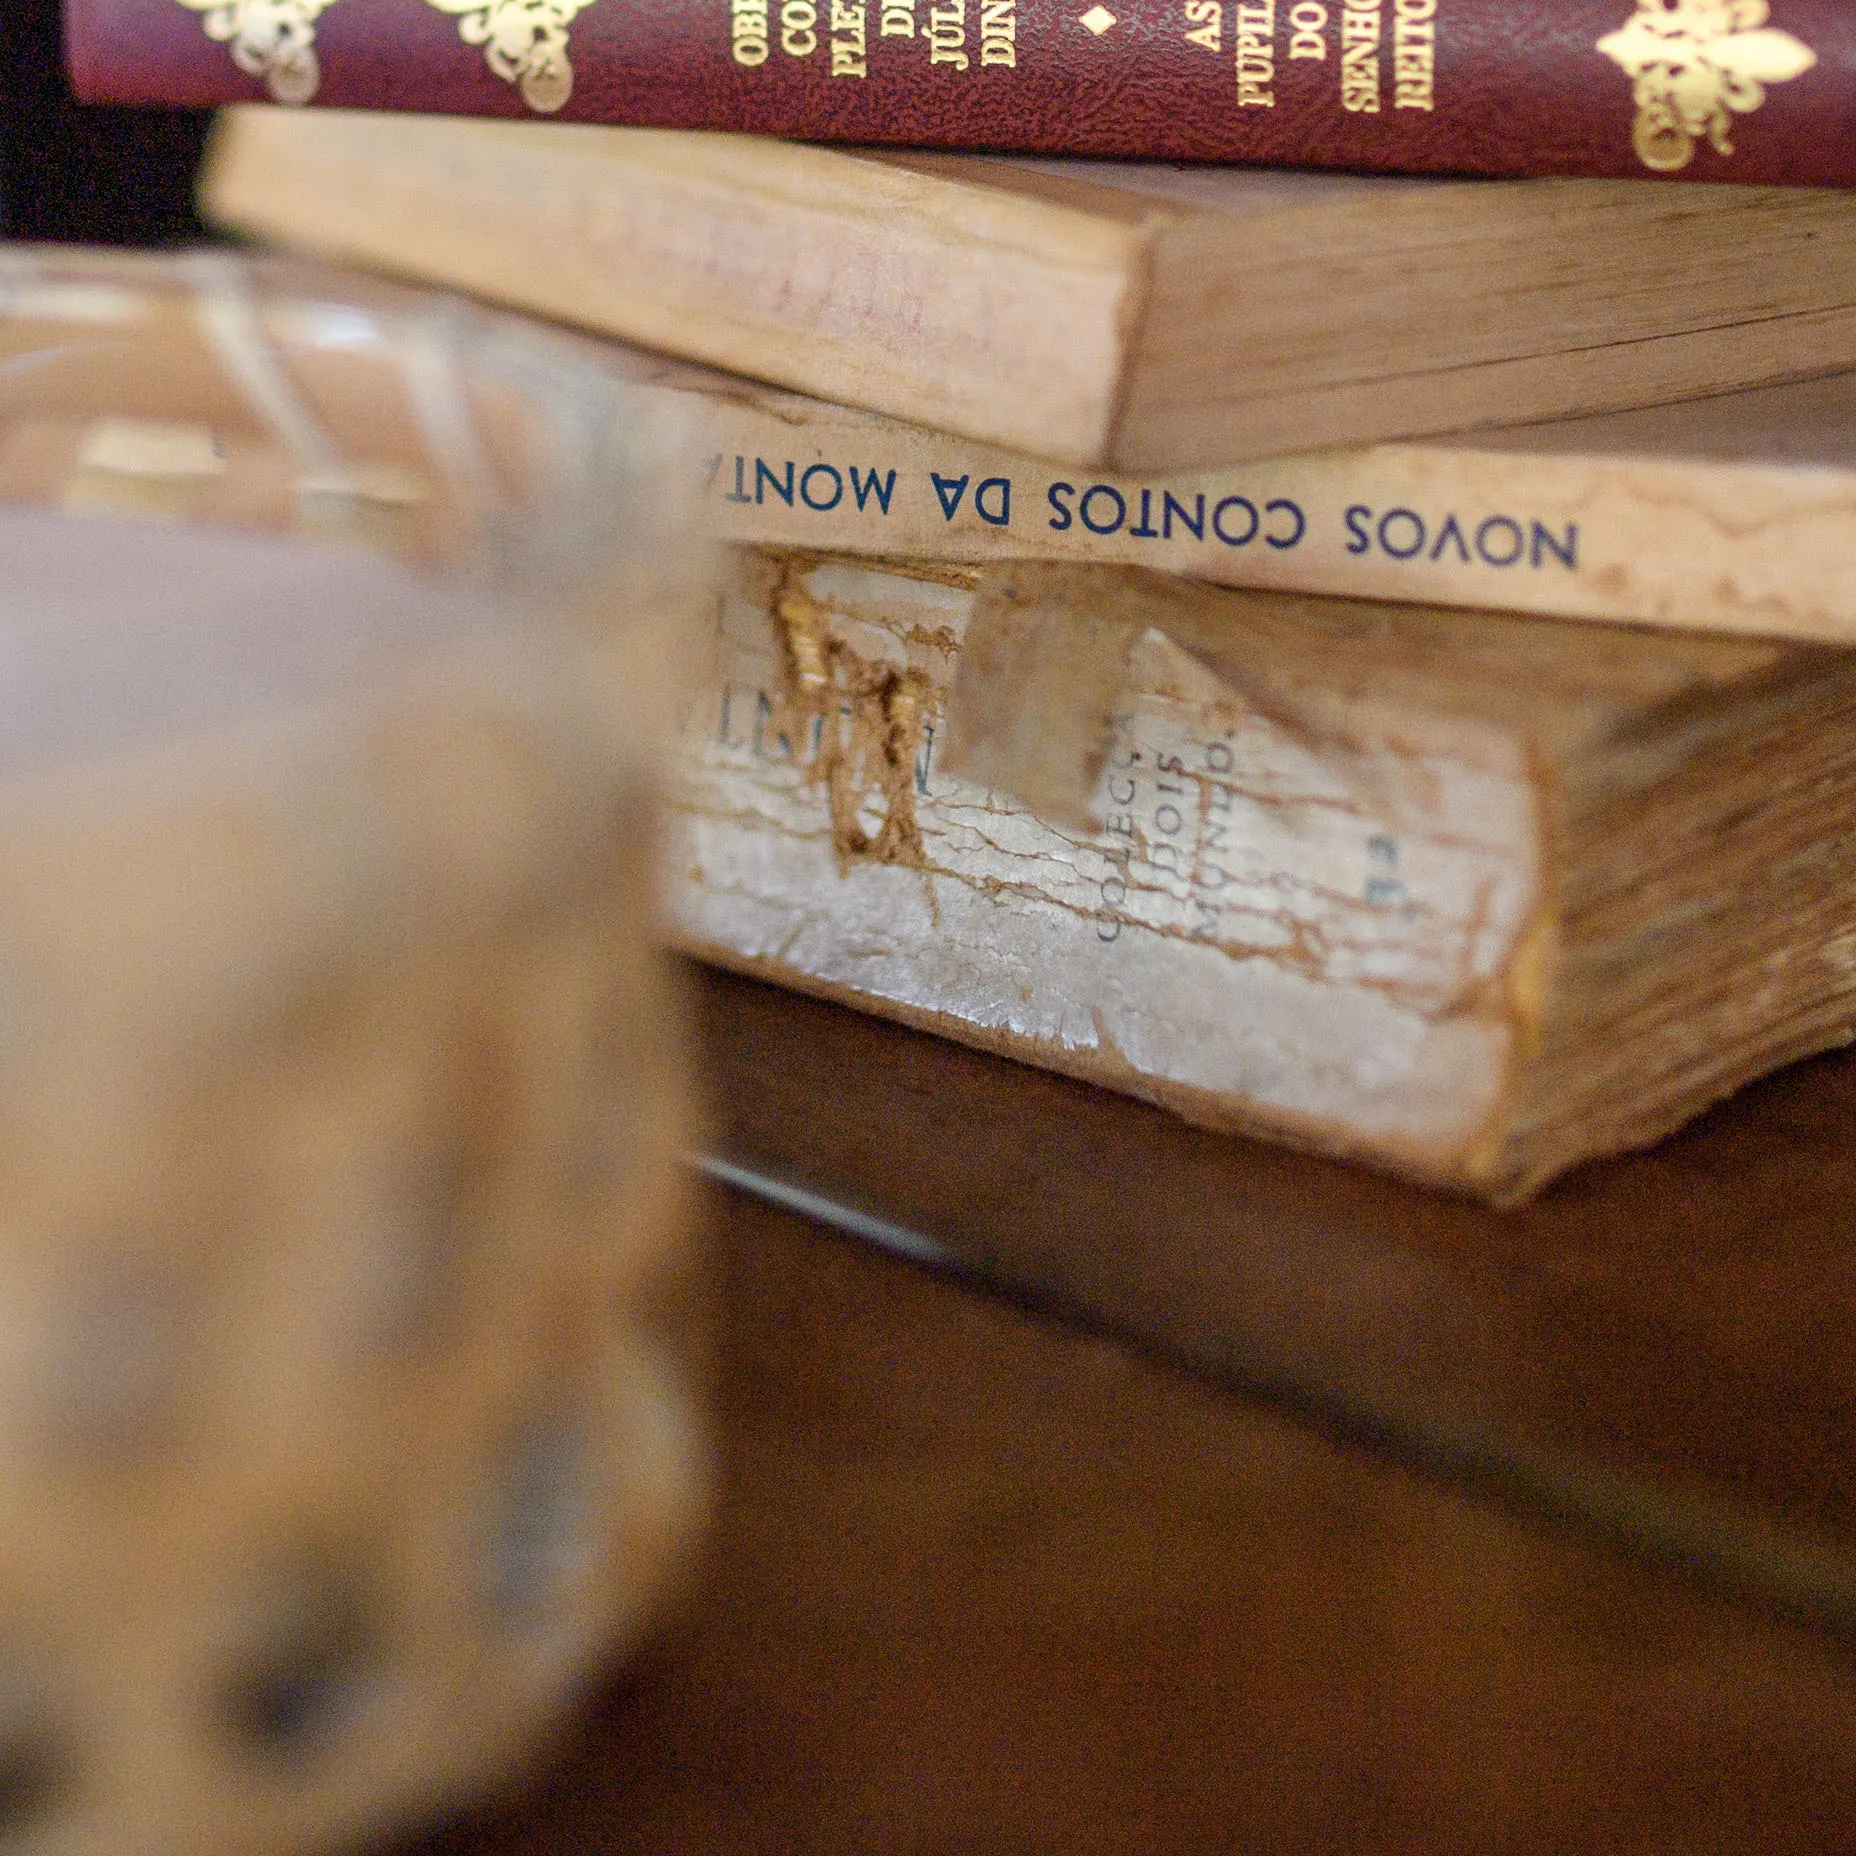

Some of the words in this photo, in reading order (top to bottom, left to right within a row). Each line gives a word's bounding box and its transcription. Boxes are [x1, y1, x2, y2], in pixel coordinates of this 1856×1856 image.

[1184, 0, 1223, 53] AS
[1288, 0, 1329, 61] DO
[929, 471, 1012, 527] DA
[1047, 481, 1308, 550] CONTOS
[1343, 503, 1580, 571] NOVOS
